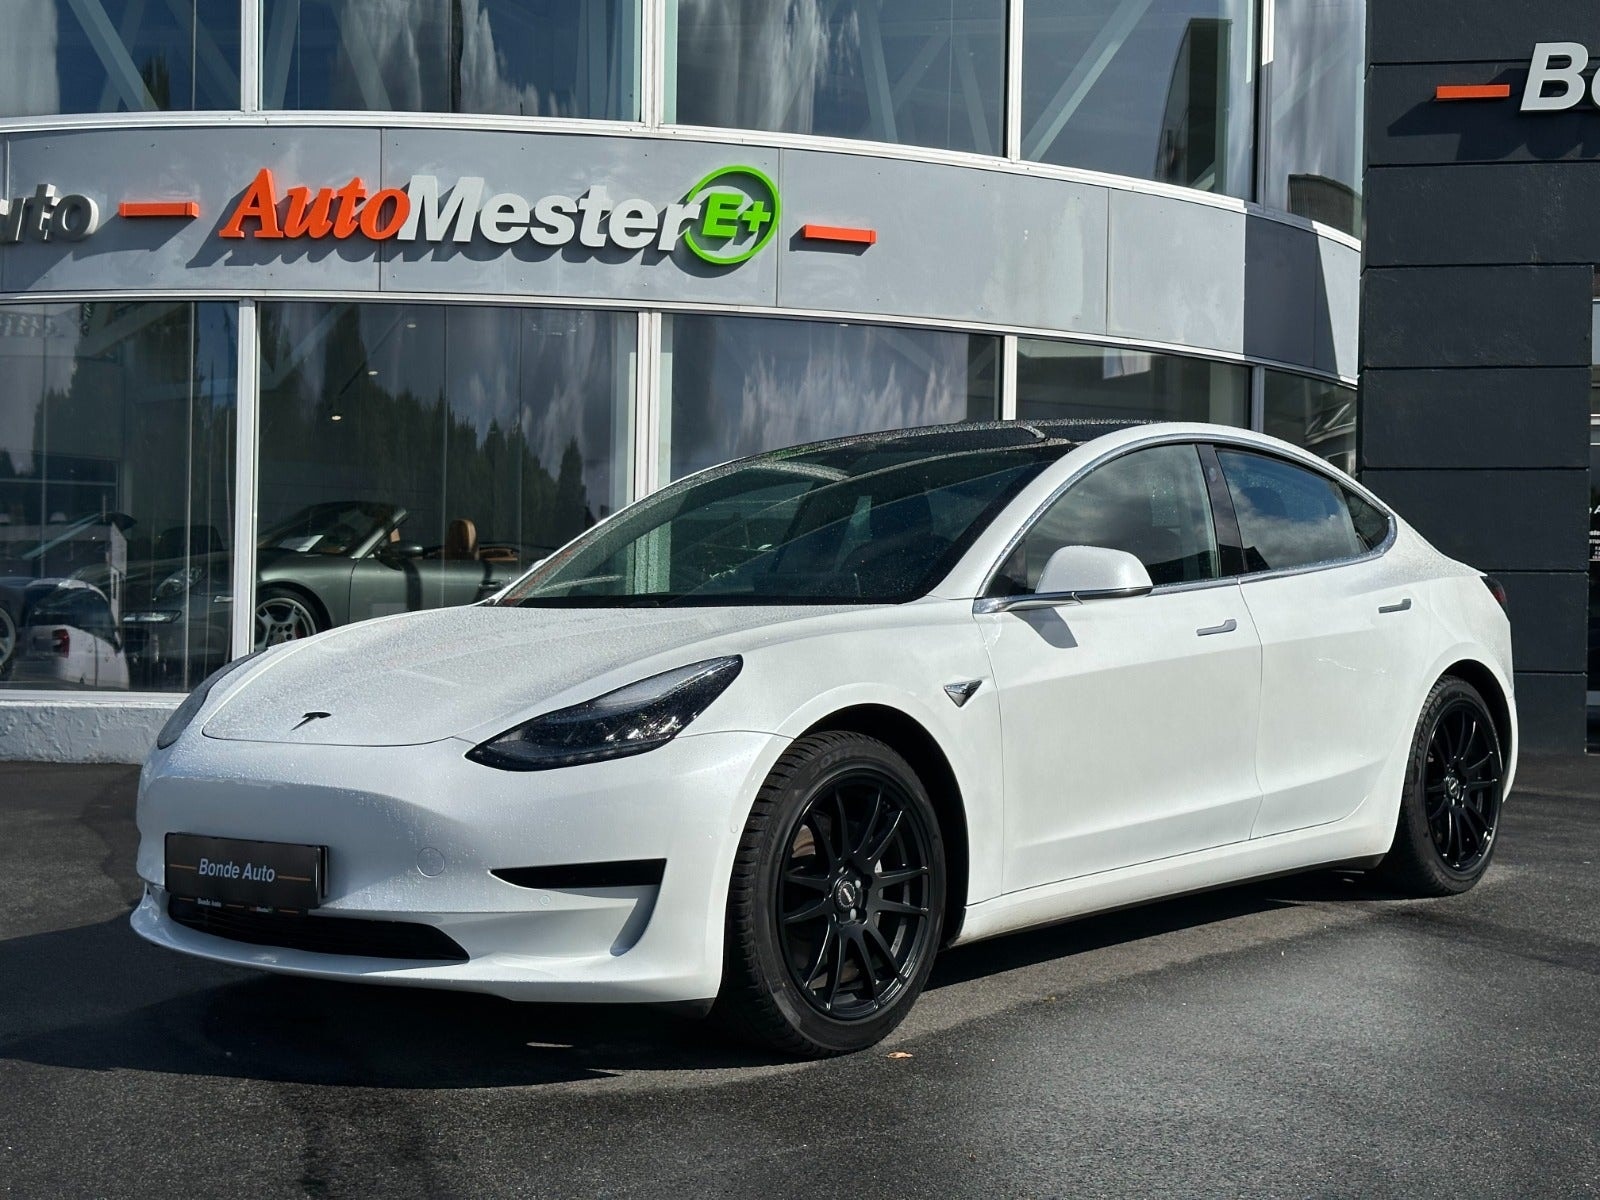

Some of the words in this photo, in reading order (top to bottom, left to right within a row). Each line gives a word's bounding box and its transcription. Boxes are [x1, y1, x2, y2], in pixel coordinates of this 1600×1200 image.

[1520, 42, 1600, 110] B
[218, 168, 701, 251] AutoMester
[199, 858, 240, 879] Bonde
[242, 863, 275, 882] Auto
